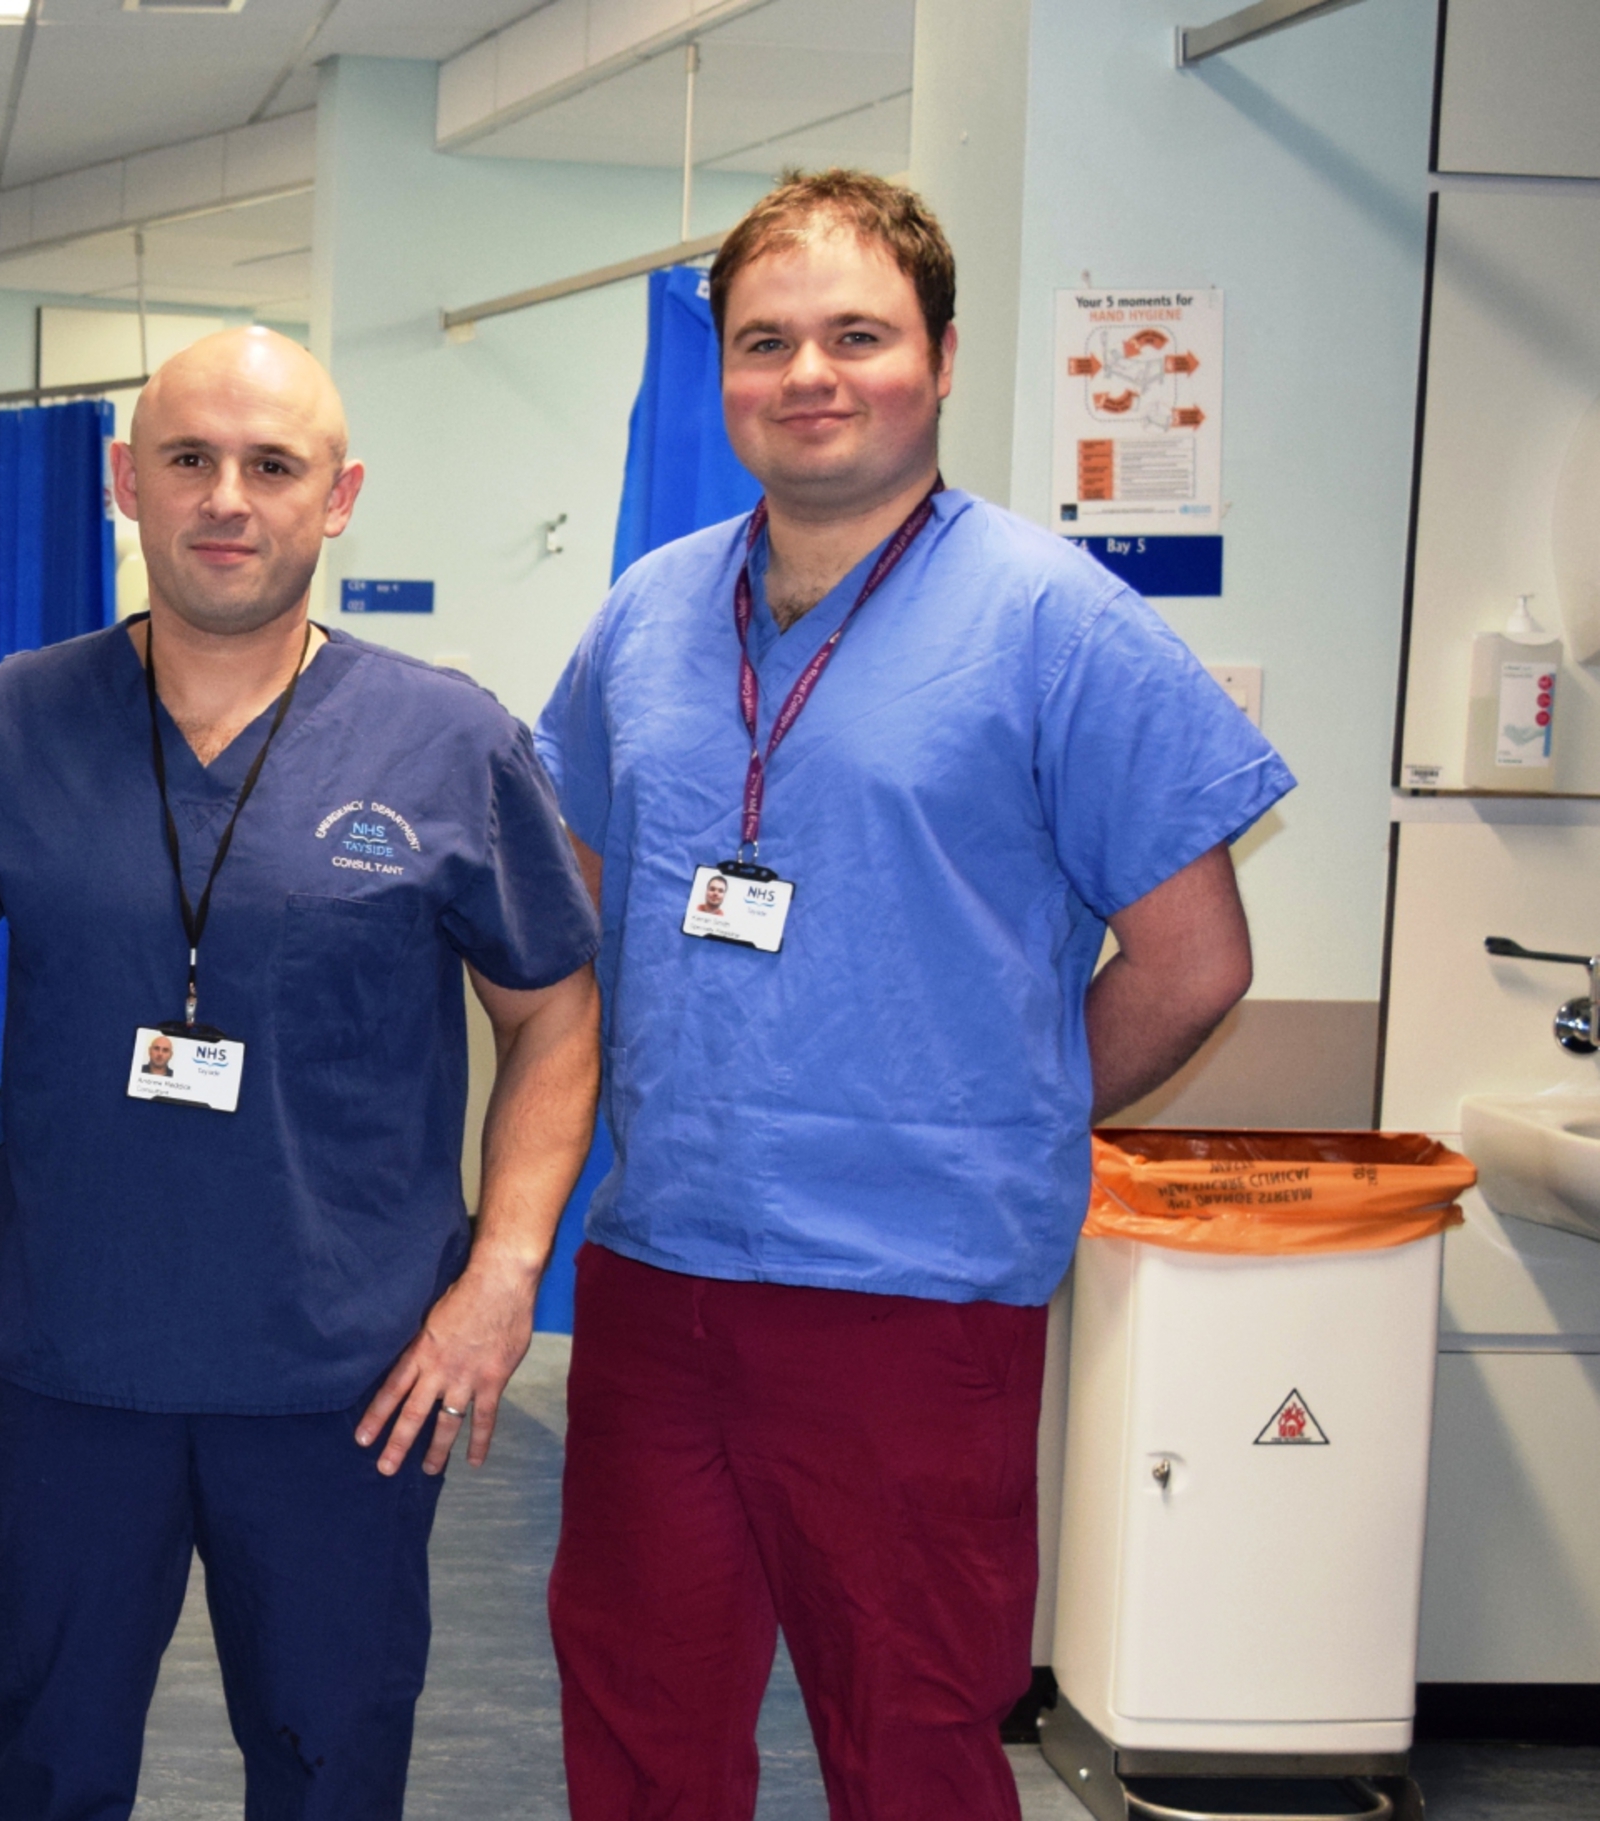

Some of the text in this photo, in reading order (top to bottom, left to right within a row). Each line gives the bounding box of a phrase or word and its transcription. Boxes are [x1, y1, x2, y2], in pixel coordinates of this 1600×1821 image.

[1076, 294, 1193, 309] Your 5 moments for
[1089, 308, 1183, 322] HAND HYGIENE
[1107, 538, 1131, 555] Bay
[1136, 538, 1146, 553] 5
[799, 668, 818, 697] Royal
[780, 693, 803, 729] College
[315, 800, 364, 839] EMERGENCY
[371, 801, 421, 852] DEPARTMENT
[353, 822, 385, 837] NHS
[342, 840, 394, 857] TAYSIDE
[331, 856, 404, 875] CONSULTANT
[747, 885, 776, 902] NHS
[196, 1045, 227, 1061] NHS
